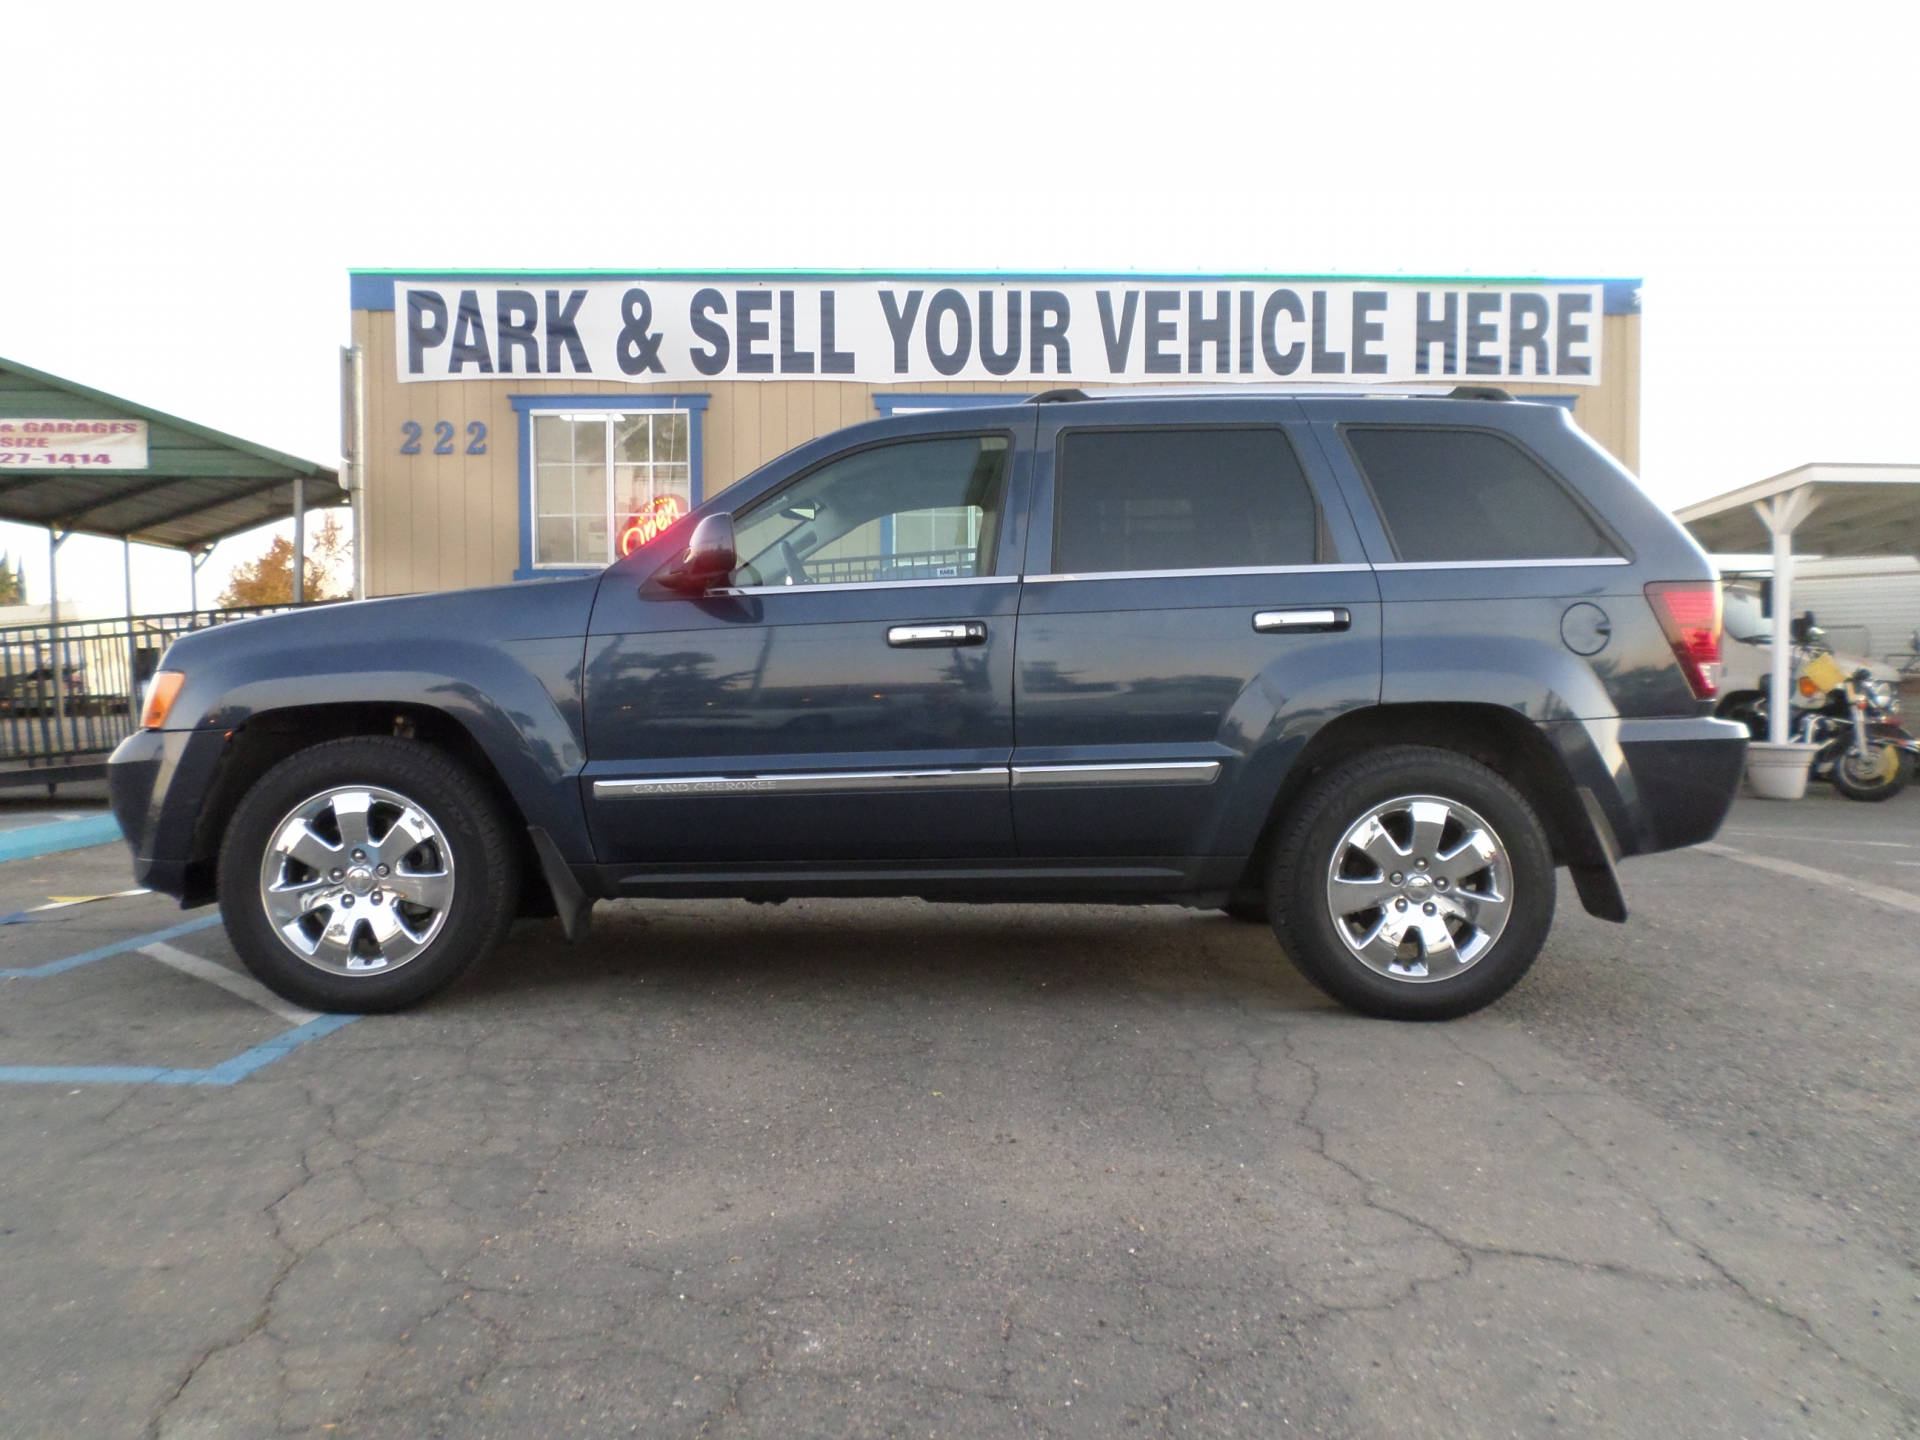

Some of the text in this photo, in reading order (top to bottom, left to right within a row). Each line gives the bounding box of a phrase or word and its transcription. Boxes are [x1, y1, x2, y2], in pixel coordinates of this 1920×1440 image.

[406, 287, 1593, 376] PARK & SELL YOUR VEHICLE HERE
[23, 422, 138, 433] GARAGES
[0, 437, 49, 448] SIZE
[622, 498, 679, 556] Open
[632, 780, 777, 794] GRAND CHEROKEE
